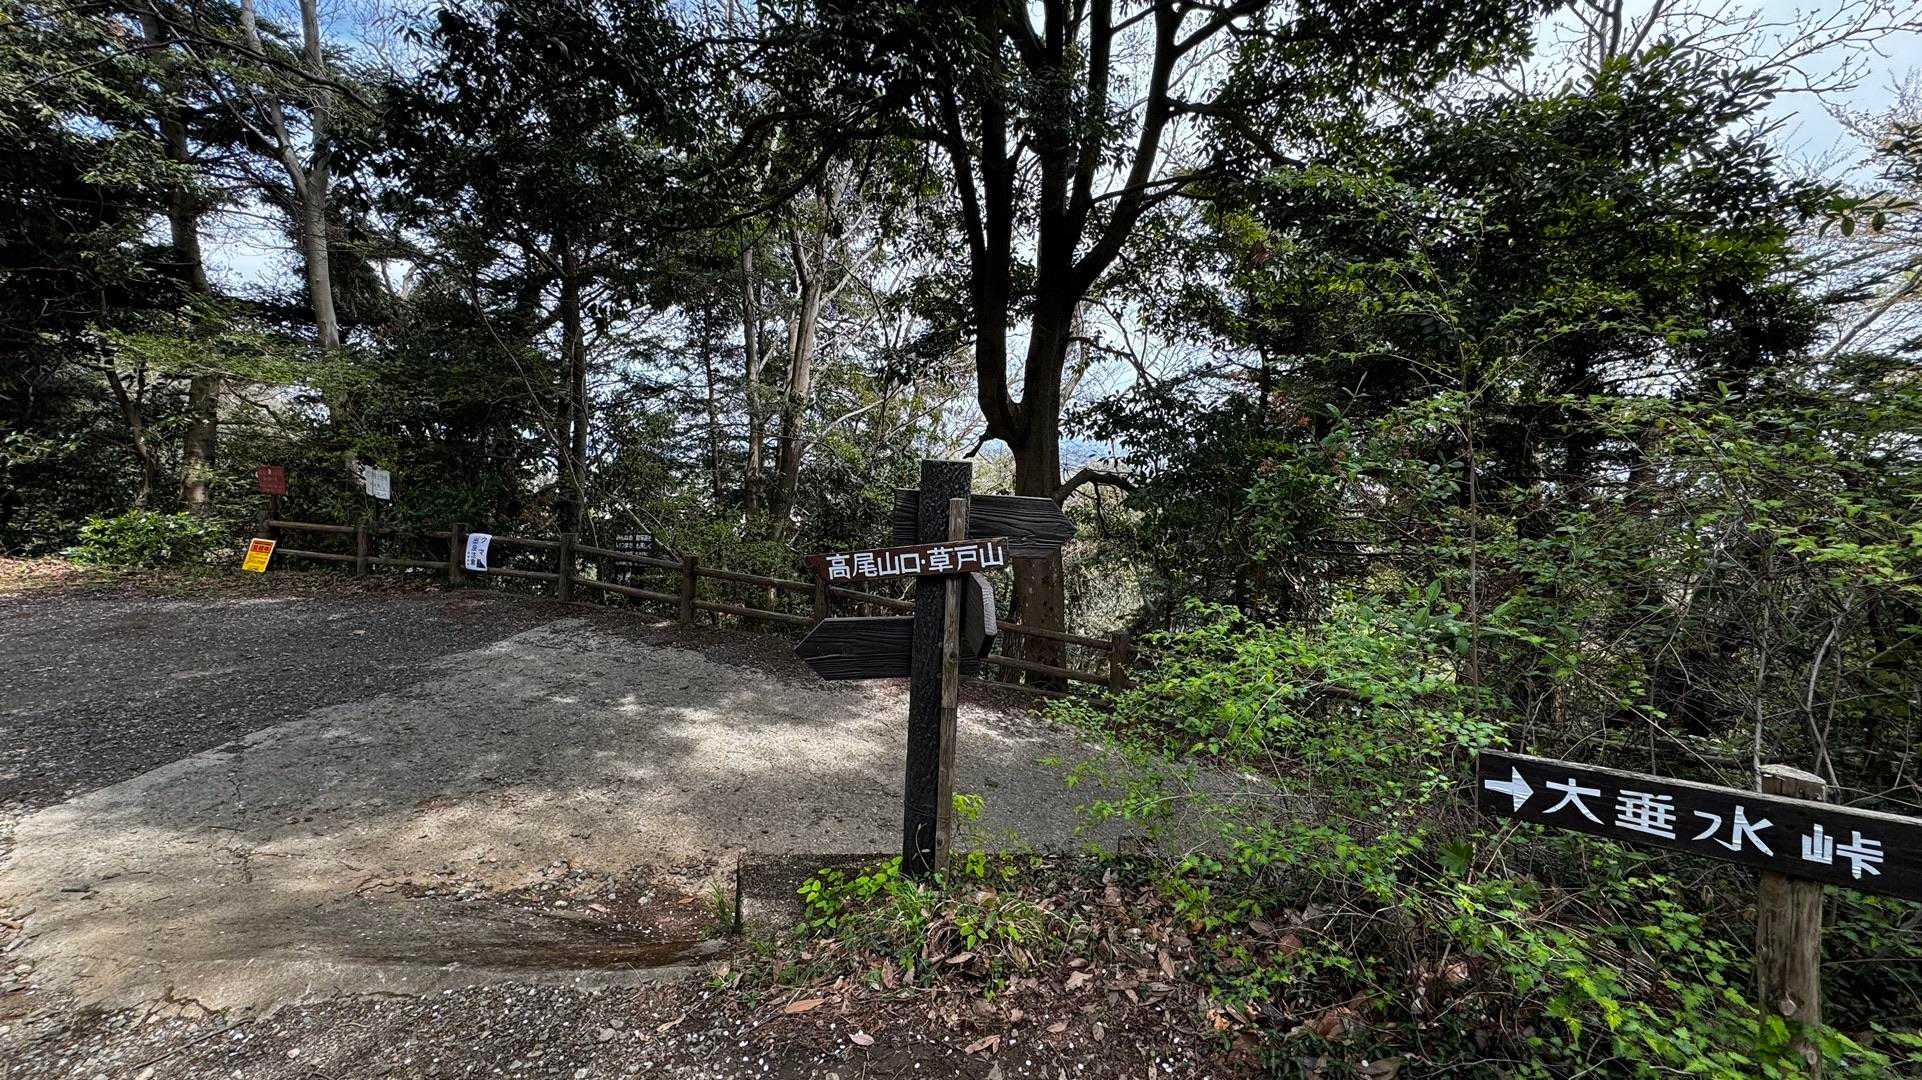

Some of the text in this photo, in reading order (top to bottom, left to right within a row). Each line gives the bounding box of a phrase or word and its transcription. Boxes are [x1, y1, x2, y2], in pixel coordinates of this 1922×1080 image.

[825, 542, 1004, 580] 高尾山口・草戸山
[1542, 778, 1884, 880] 大垂水峠
